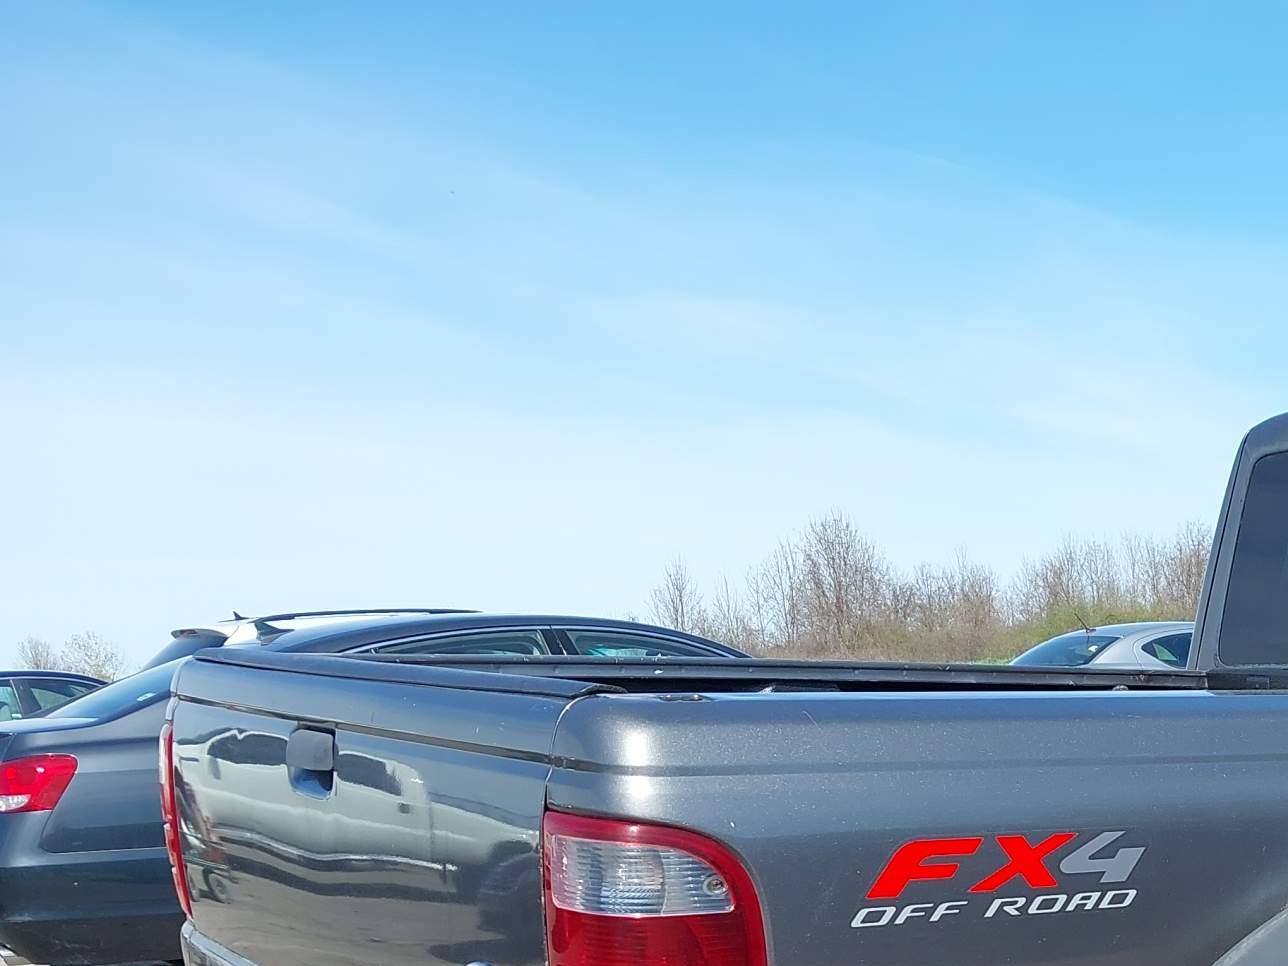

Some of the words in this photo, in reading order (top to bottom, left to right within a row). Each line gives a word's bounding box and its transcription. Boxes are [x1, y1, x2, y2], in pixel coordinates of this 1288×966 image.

[864, 831, 1147, 900] FX4
[850, 901, 968, 928] OFF
[983, 889, 1138, 918] ROAD
